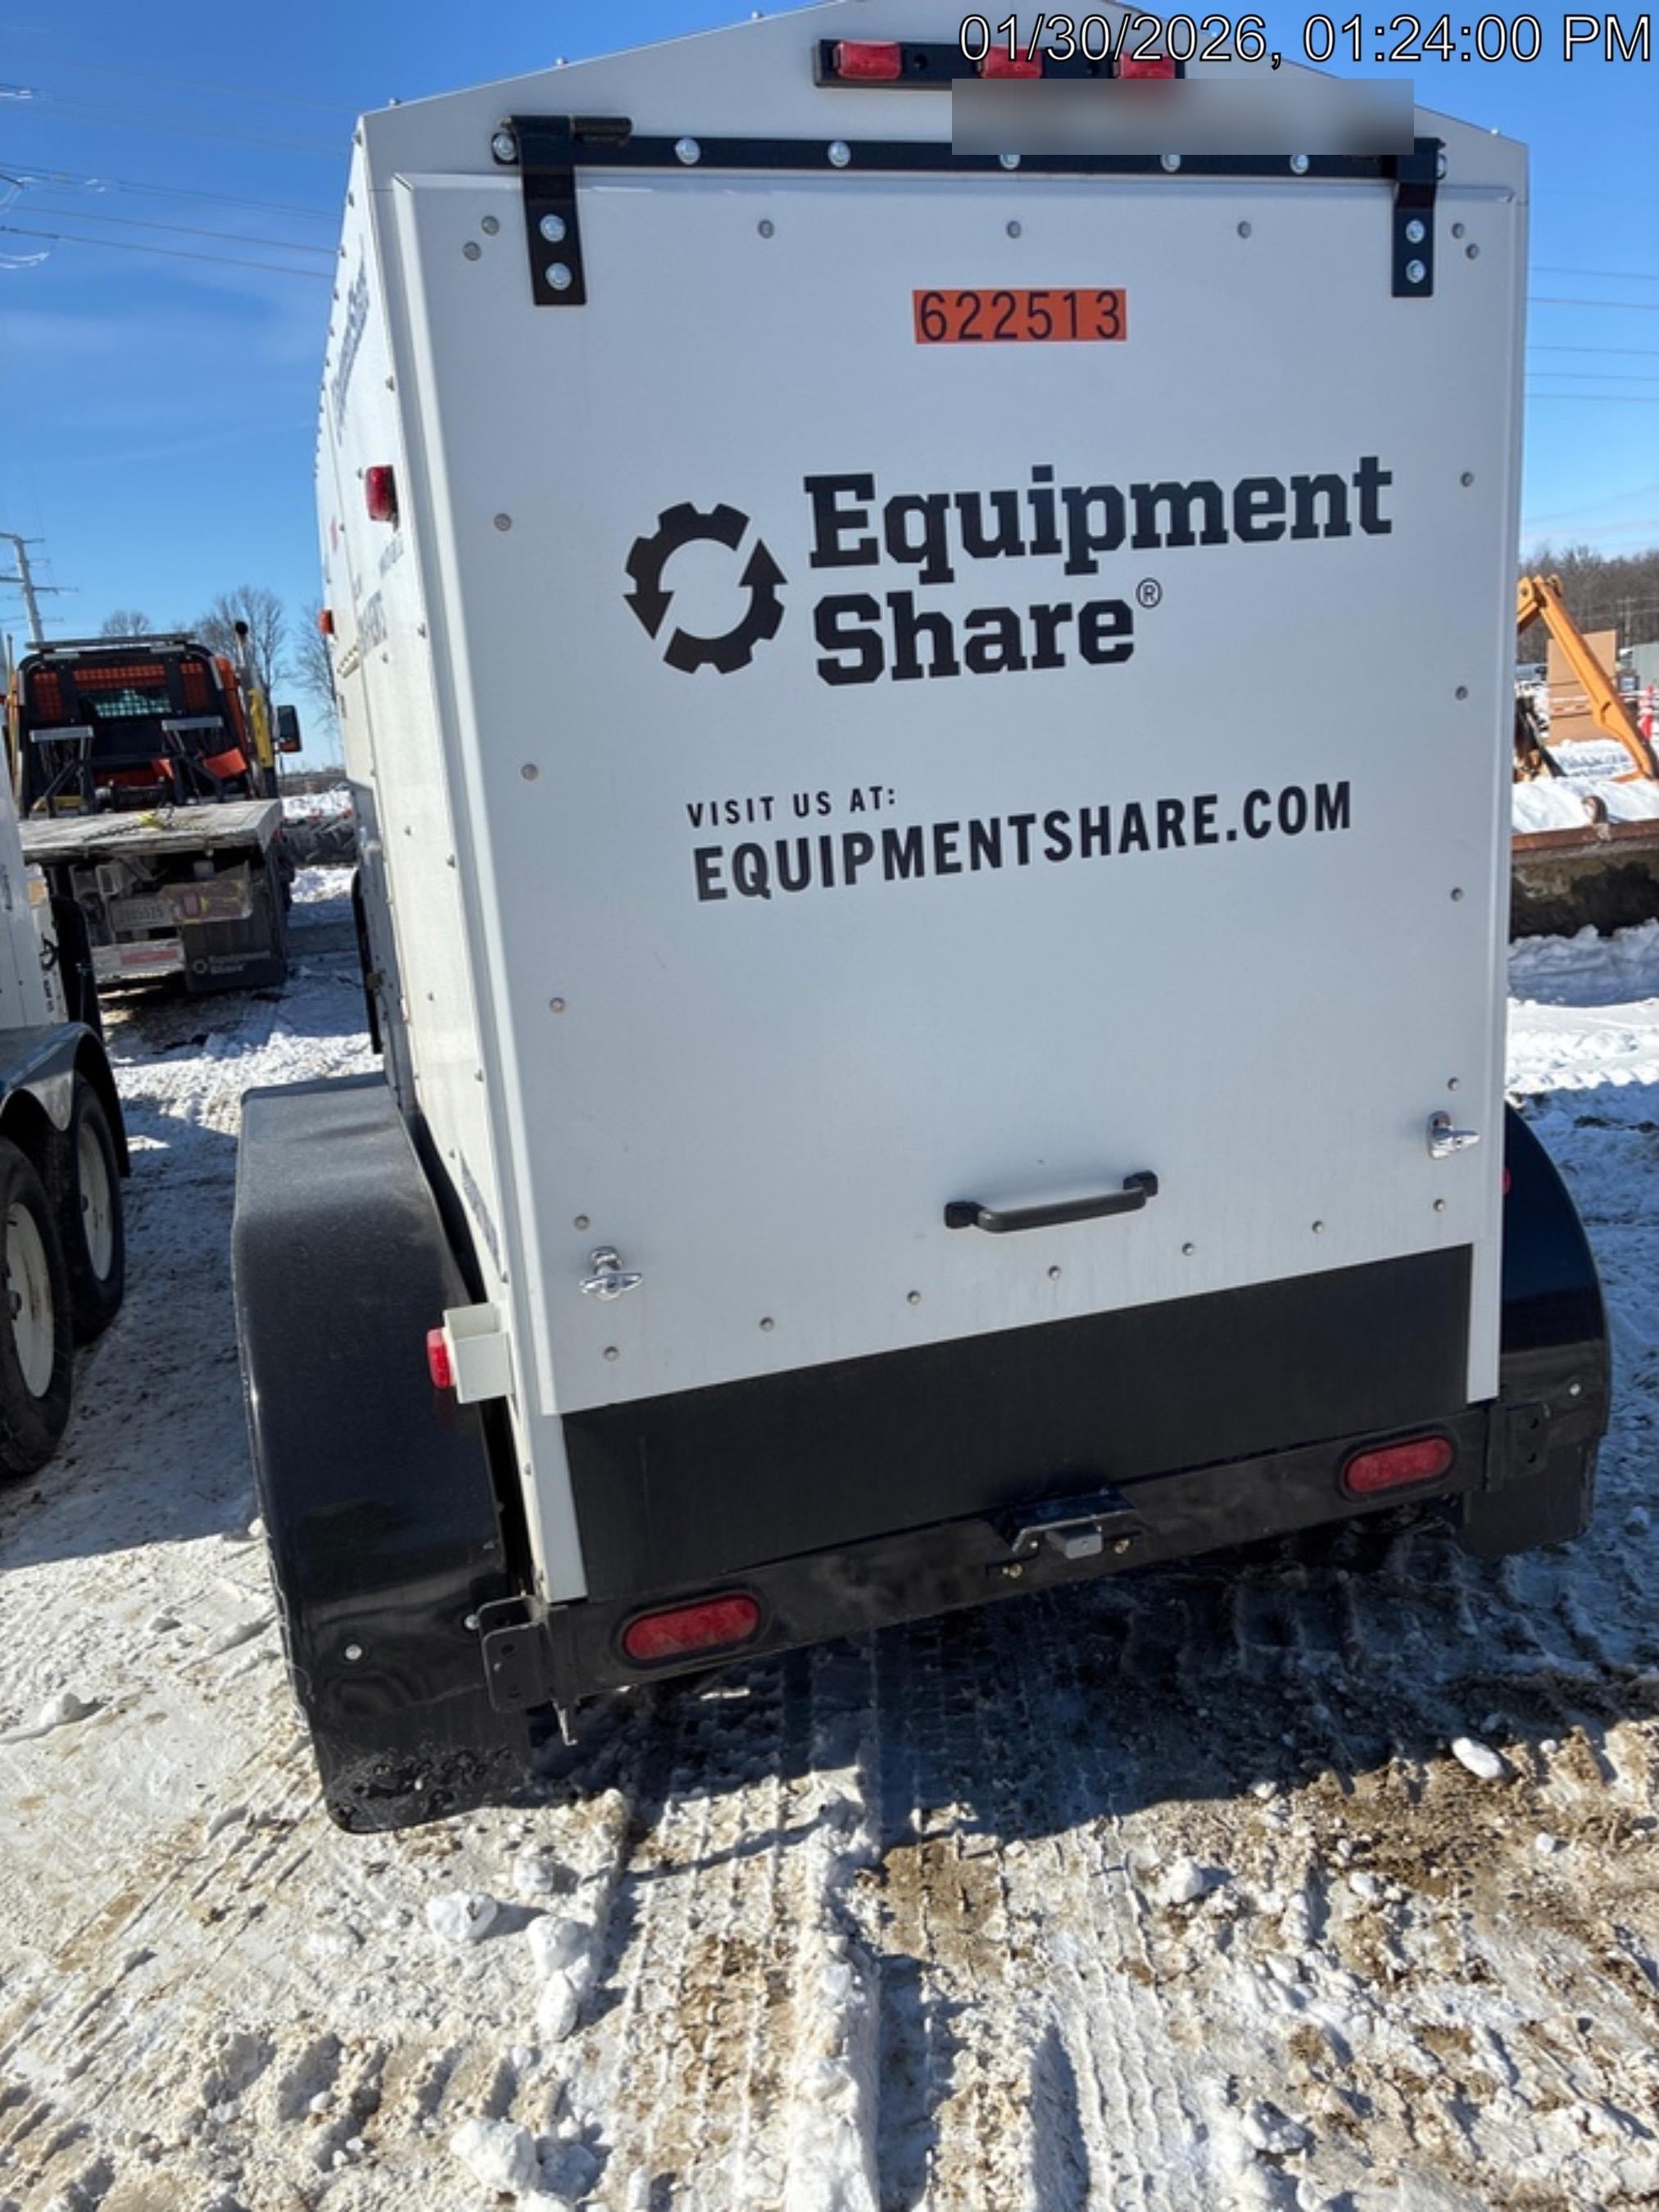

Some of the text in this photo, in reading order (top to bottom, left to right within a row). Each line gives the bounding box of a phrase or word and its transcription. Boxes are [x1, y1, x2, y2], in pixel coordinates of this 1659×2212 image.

[920, 290, 1120, 342] 622513
[803, 456, 1393, 585] Equipment
[686, 785, 895, 828] VISIT US AT:
[693, 781, 1351, 902] EQUIPMENTSHARE.COM
